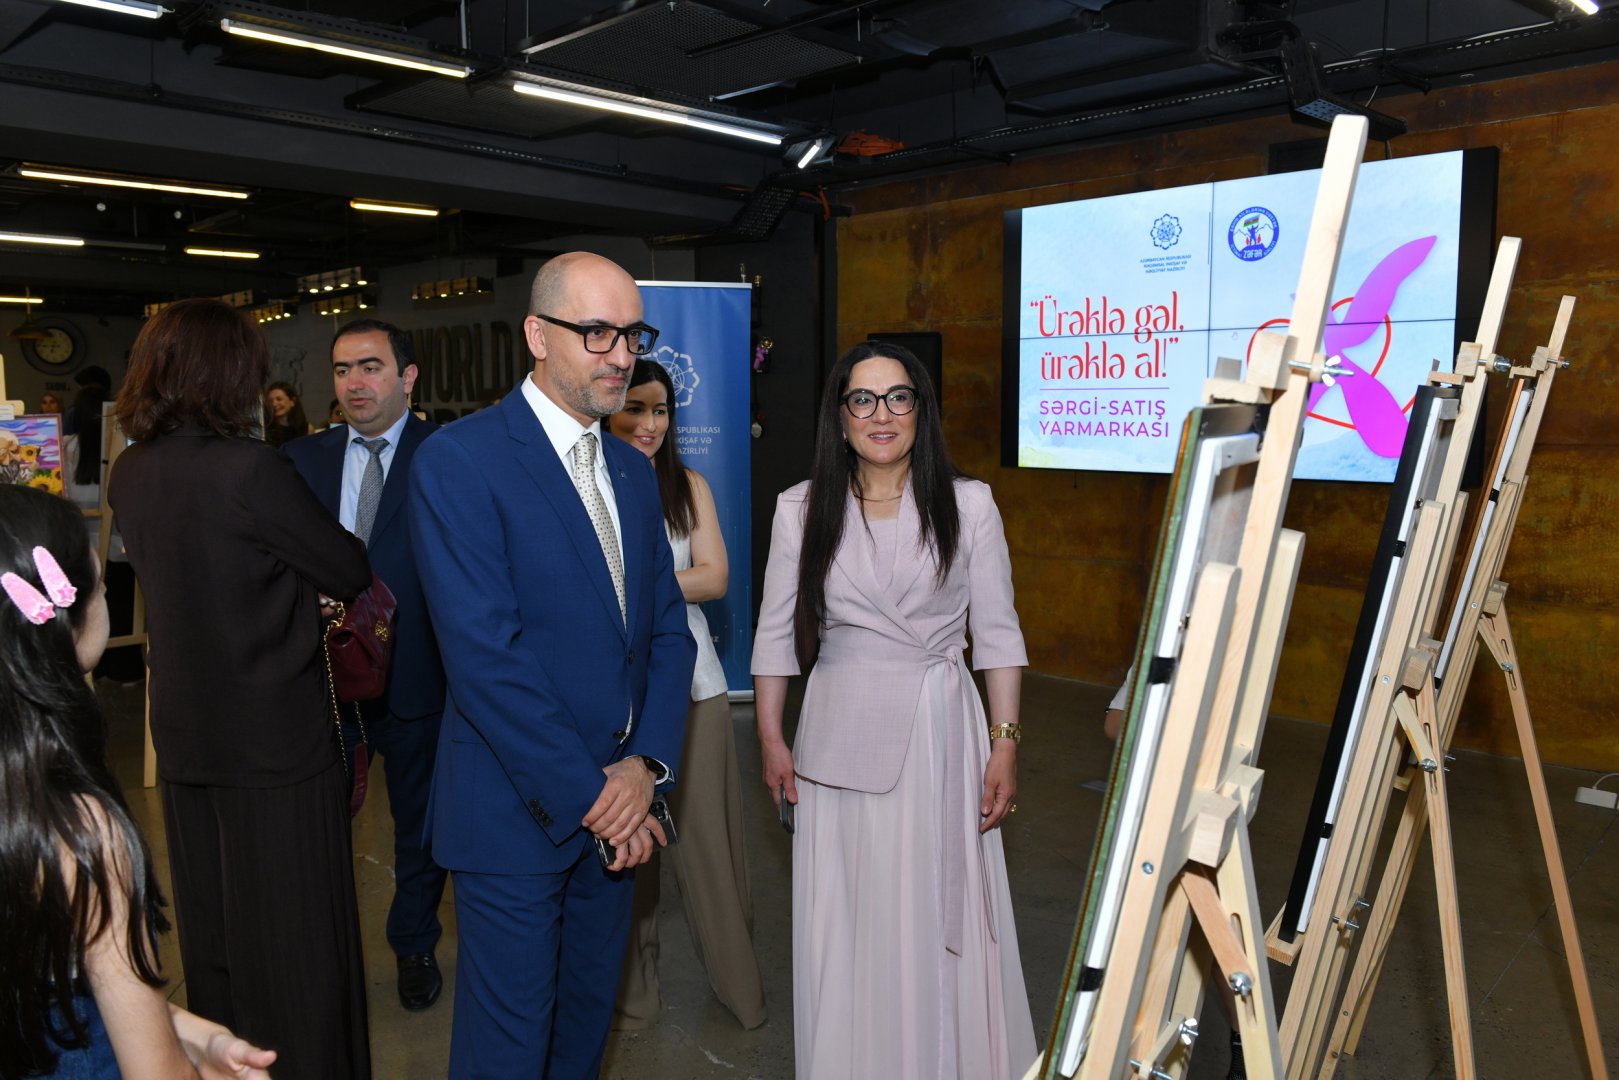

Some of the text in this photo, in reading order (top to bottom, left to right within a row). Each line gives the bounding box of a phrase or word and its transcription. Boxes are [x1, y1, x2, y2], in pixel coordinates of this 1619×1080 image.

[1133, 290, 1184, 344] gəl,
[406, 321, 514, 403] WORLD
[1041, 340, 1126, 380] ürəklə
[1039, 396, 1166, 420] SƏRGİ-SATIŞ
[676, 426, 721, 434] SPUBLİKASI
[1039, 420, 1169, 438] YARMARKASI
[677, 446, 708, 455] AZİRLİYİ
[700, 436, 712, 444] VƏ
